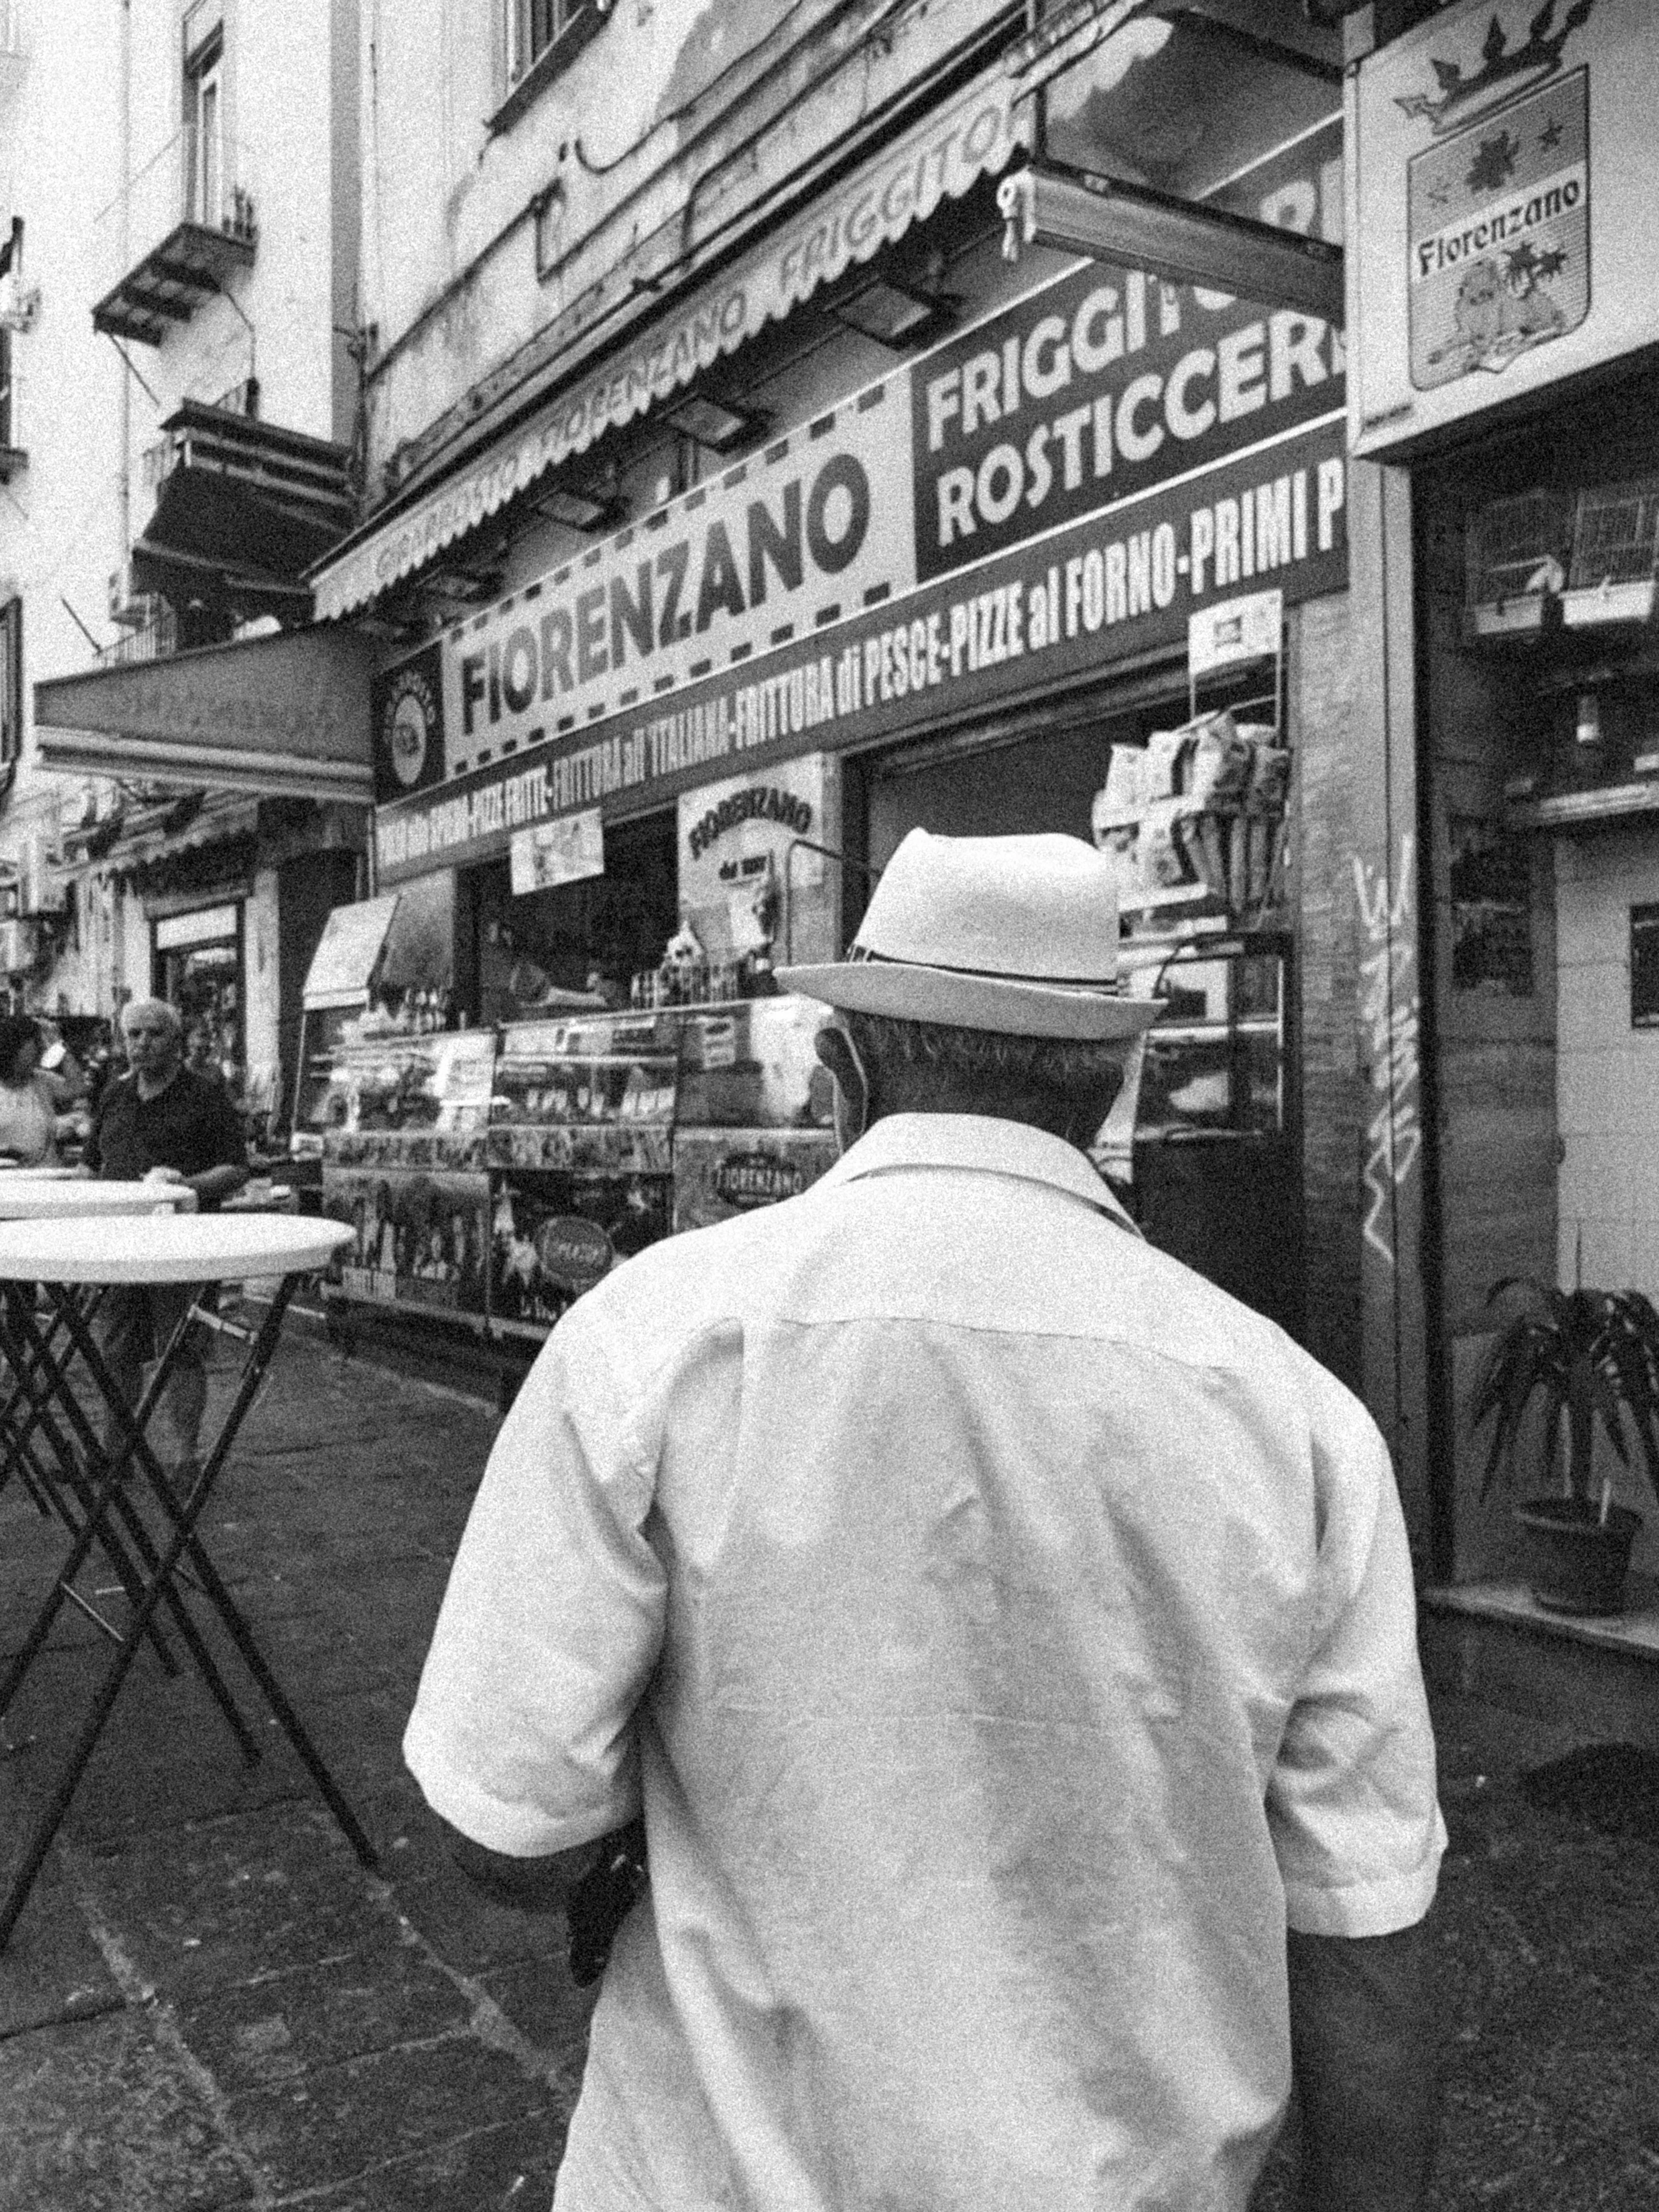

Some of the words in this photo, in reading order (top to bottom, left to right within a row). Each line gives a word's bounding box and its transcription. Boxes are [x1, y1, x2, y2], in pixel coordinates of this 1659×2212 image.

[539, 295, 745, 450] FIORENZANO
[463, 453, 871, 736] FIORENZANO
[837, 644, 861, 717] di
[1029, 566, 1060, 650] al
